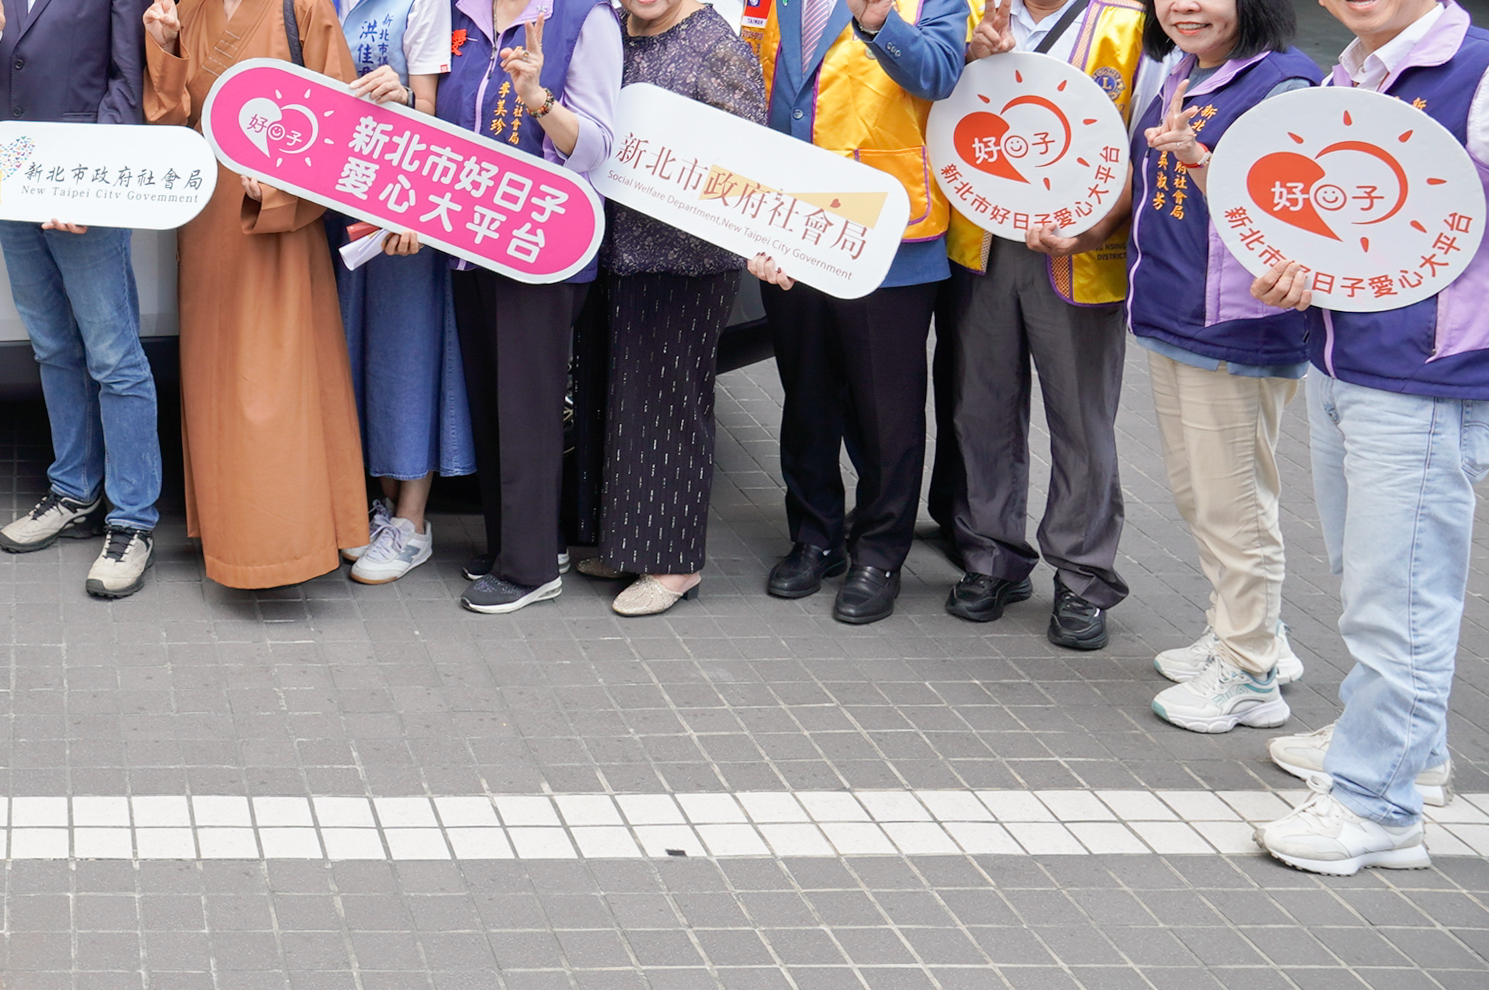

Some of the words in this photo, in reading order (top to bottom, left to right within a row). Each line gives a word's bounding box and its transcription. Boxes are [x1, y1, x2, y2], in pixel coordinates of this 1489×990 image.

[490, 81, 511, 136] 李美珍
[21, 184, 46, 196] New
[52, 186, 90, 199] Taipei
[24, 161, 204, 191] 新北市政府社會局
[335, 156, 547, 264] 愛心大平台
[347, 115, 571, 225] 新北市好日子
[614, 132, 869, 261] 新北市政府社會局
[940, 145, 1121, 230] 新北市好日子愛心大平台
[607, 169, 634, 187] Social
[634, 181, 666, 201] Welfare
[743, 226, 772, 247] Taipei
[772, 239, 791, 256] City
[792, 247, 853, 281] Government
[1224, 205, 1473, 298] 新北市日子愛心大平台
